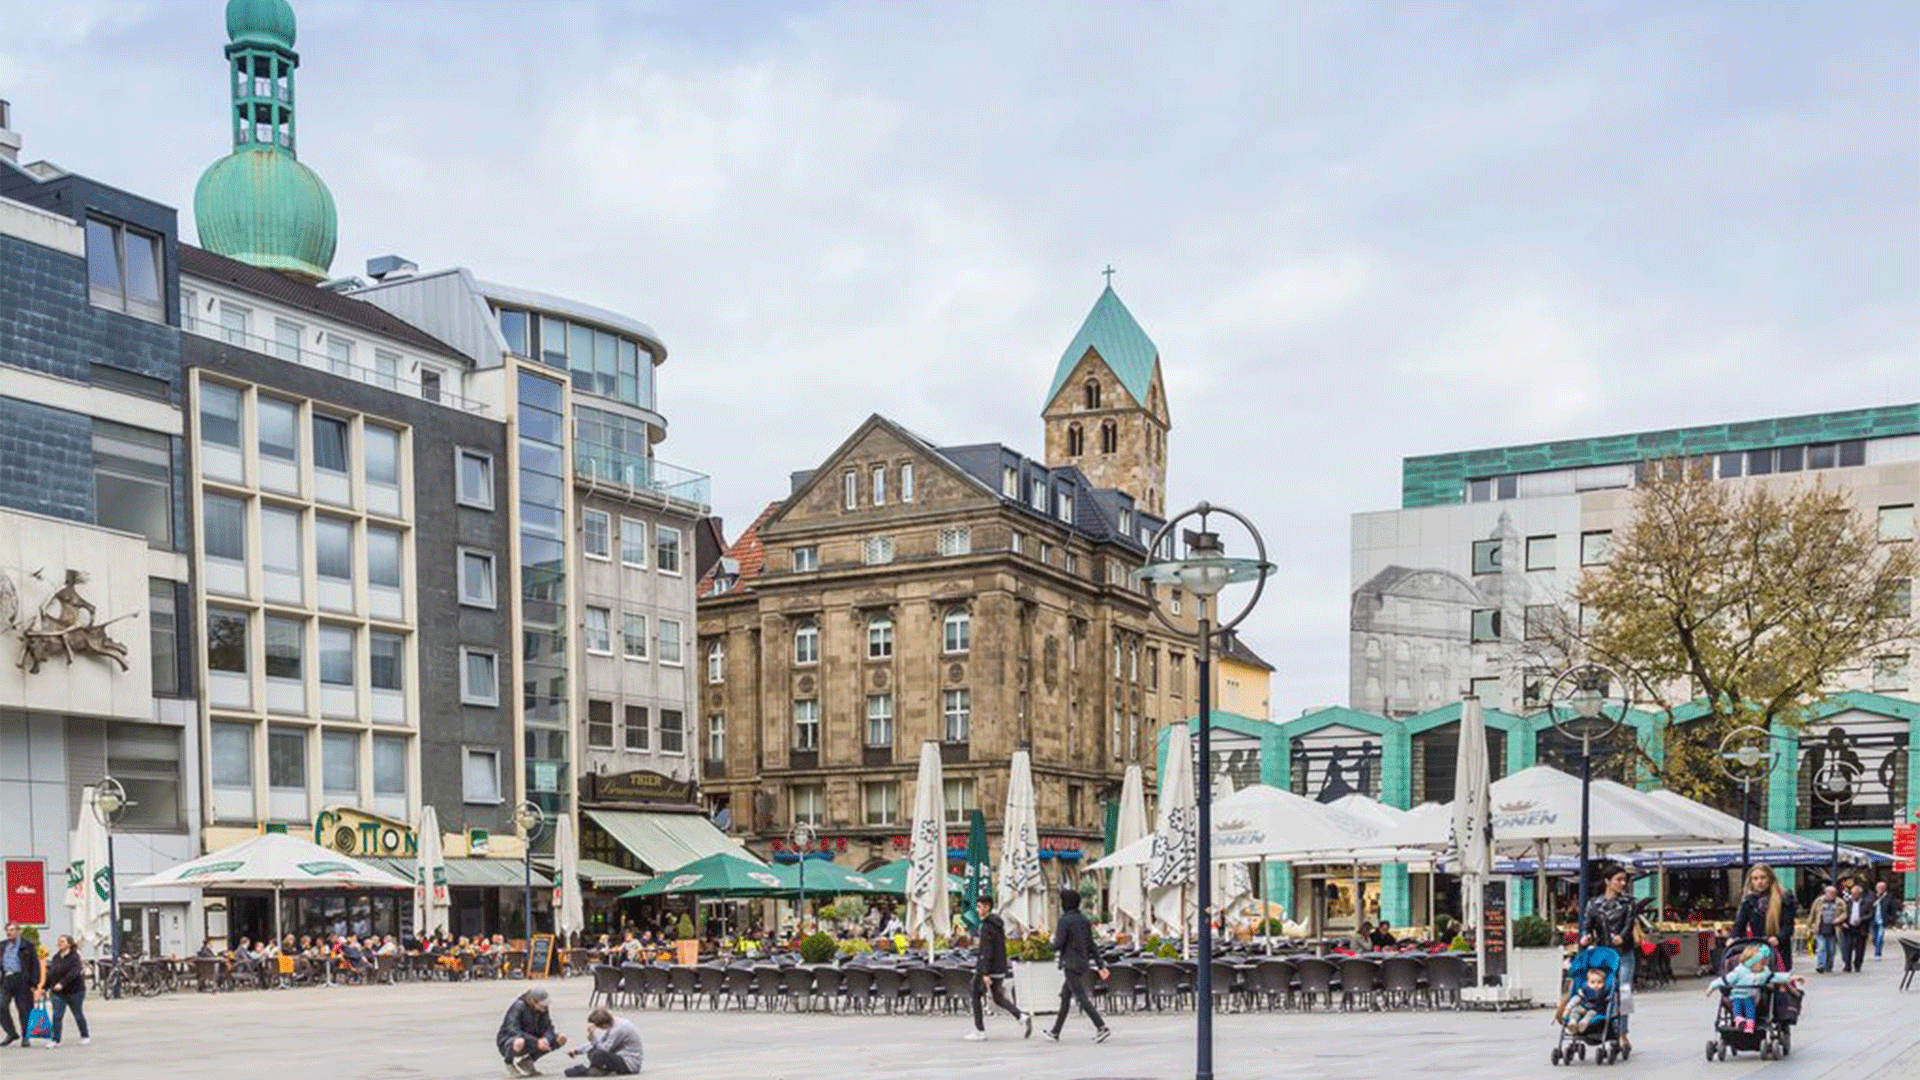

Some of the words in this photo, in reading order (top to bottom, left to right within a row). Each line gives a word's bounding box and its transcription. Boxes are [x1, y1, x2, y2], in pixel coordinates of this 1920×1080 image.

[630, 774, 661, 786] THIER
[1493, 814, 1557, 828] ONEN
[315, 811, 418, 853] COTTON
